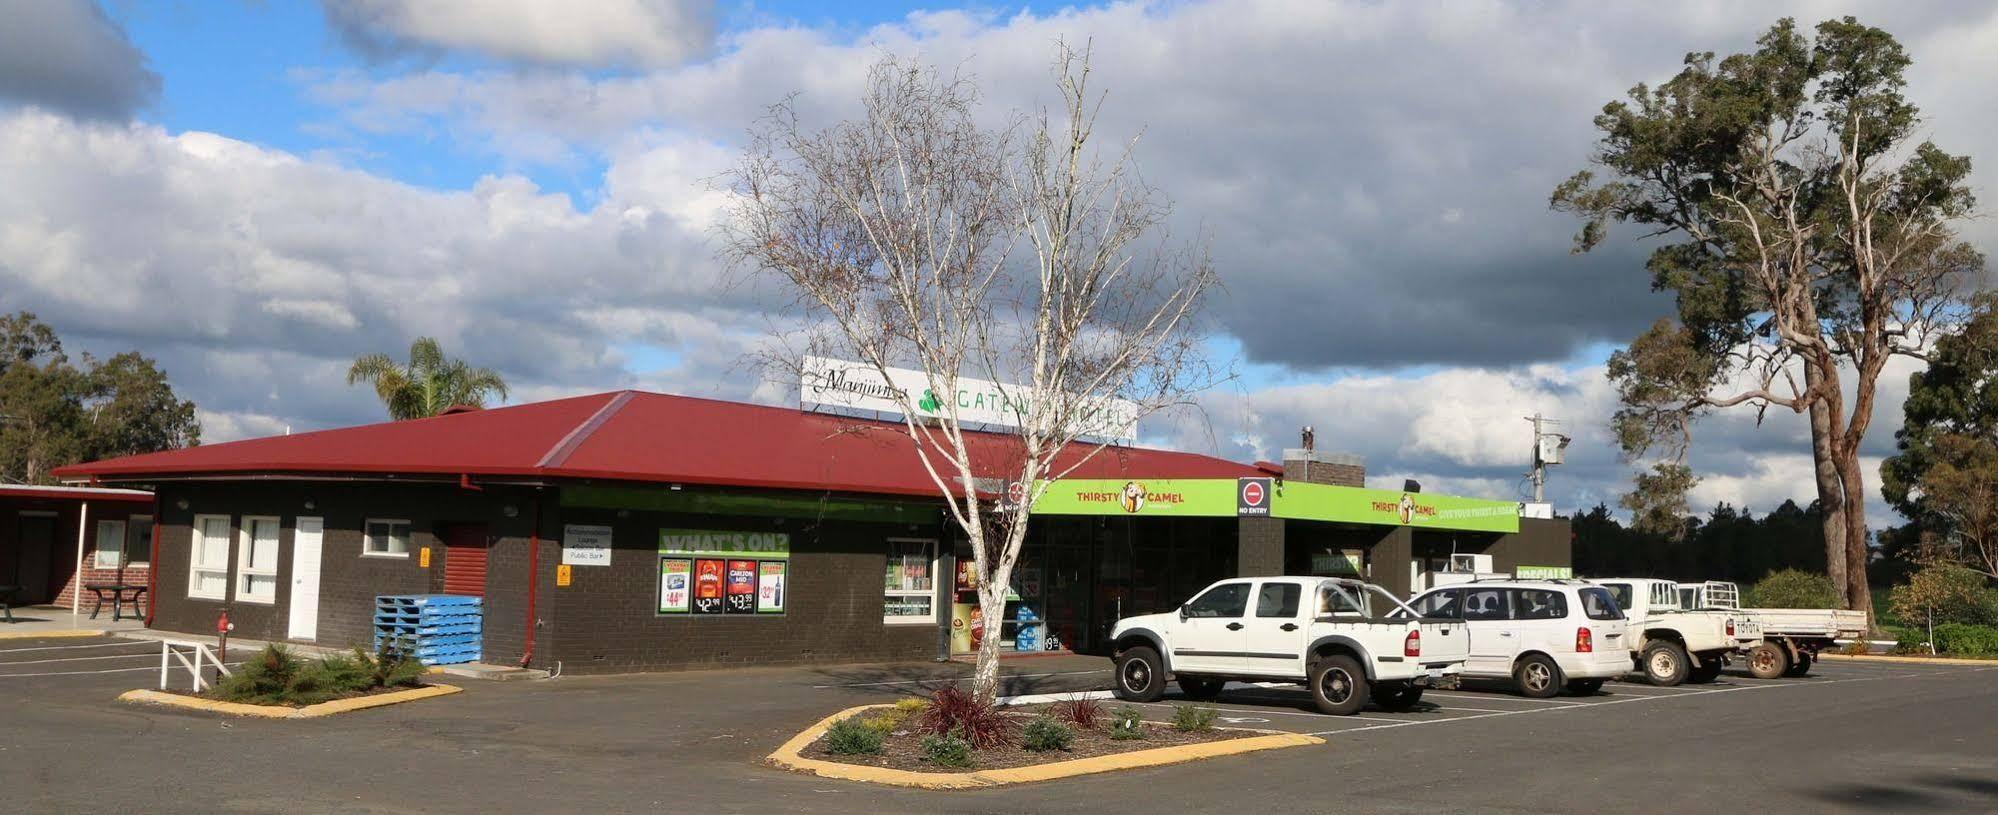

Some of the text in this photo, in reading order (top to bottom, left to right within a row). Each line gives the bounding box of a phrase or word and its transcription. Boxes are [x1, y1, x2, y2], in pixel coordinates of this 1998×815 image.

[1077, 492, 1184, 503] THIRSTY CAMEL
[1372, 501, 1436, 516] THIRSTY CAMEL
[663, 533, 787, 553] WHAT'S ON?
[1737, 623, 1760, 633] TOYOTA
